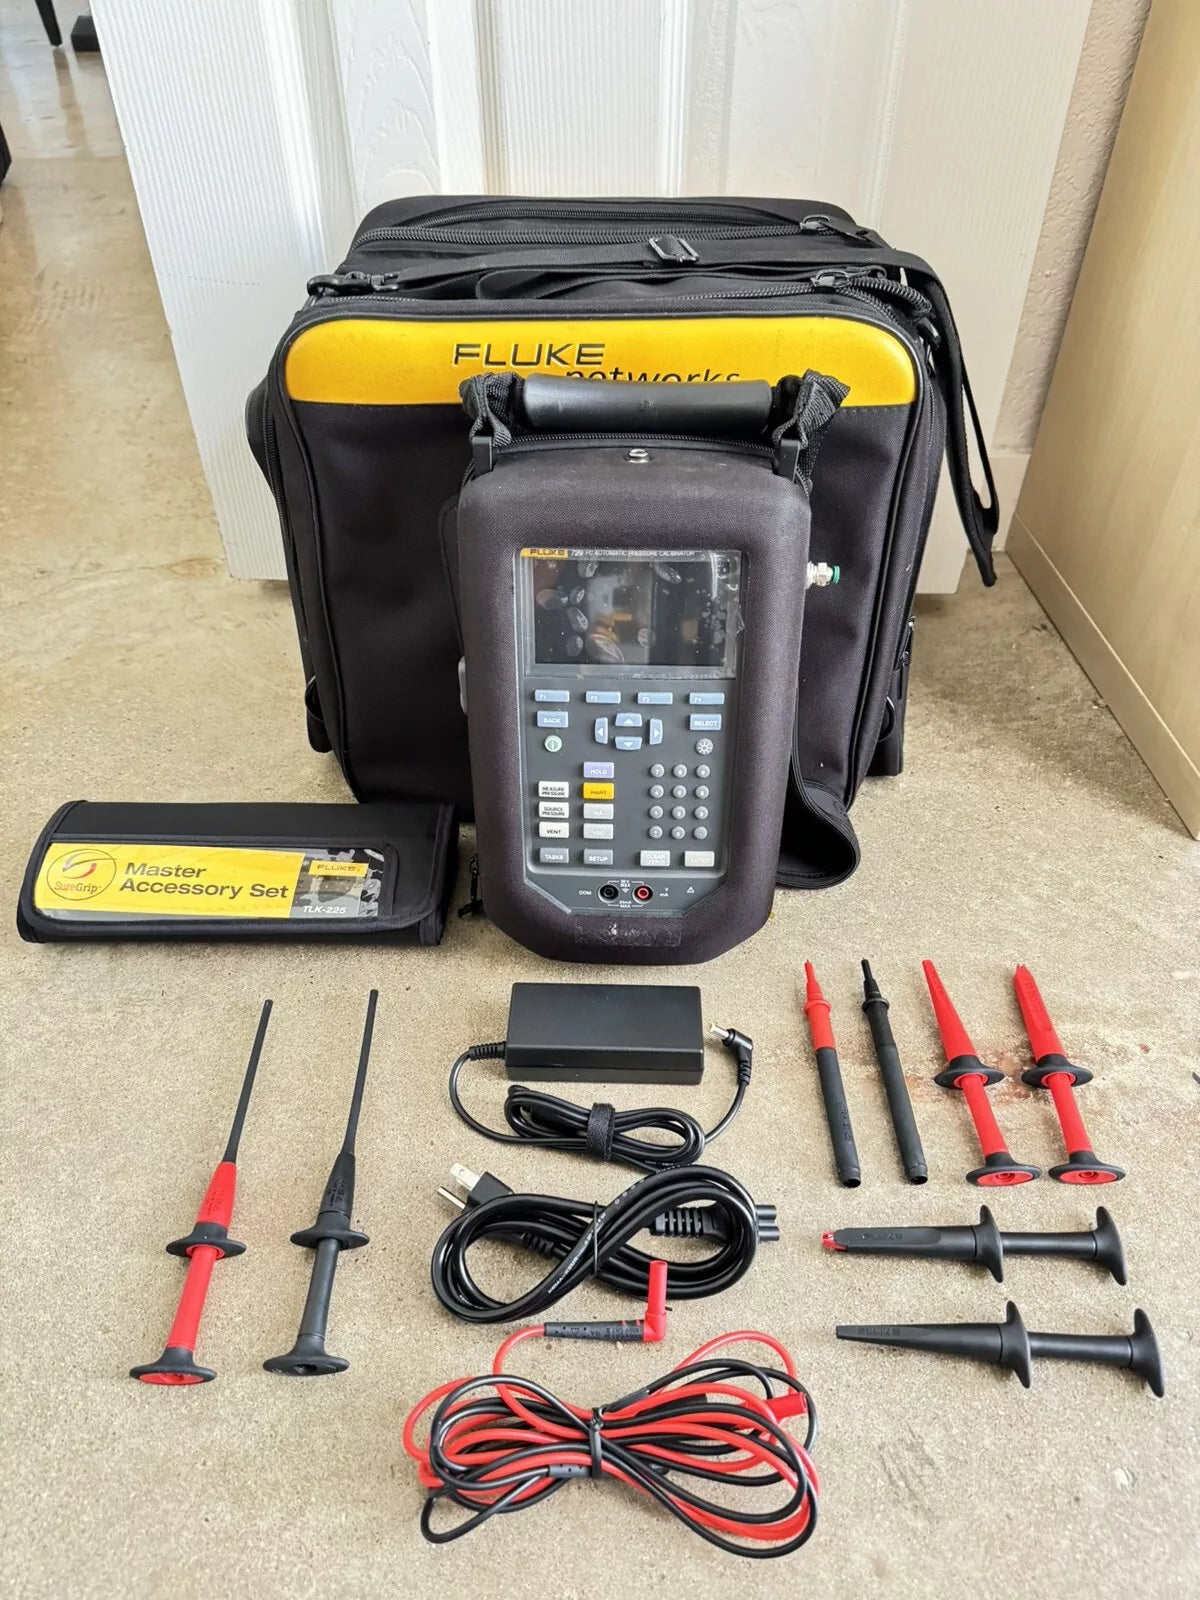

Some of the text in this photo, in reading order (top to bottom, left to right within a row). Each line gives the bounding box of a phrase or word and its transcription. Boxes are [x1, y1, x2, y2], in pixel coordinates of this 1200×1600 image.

[453, 343, 605, 366] FLUKE
[529, 548, 565, 556] FLUKE
[124, 861, 206, 879] Master
[316, 864, 357, 872] FLUKE
[120, 877, 289, 899] Accessory Set
[303, 905, 347, 914] TLK-225
